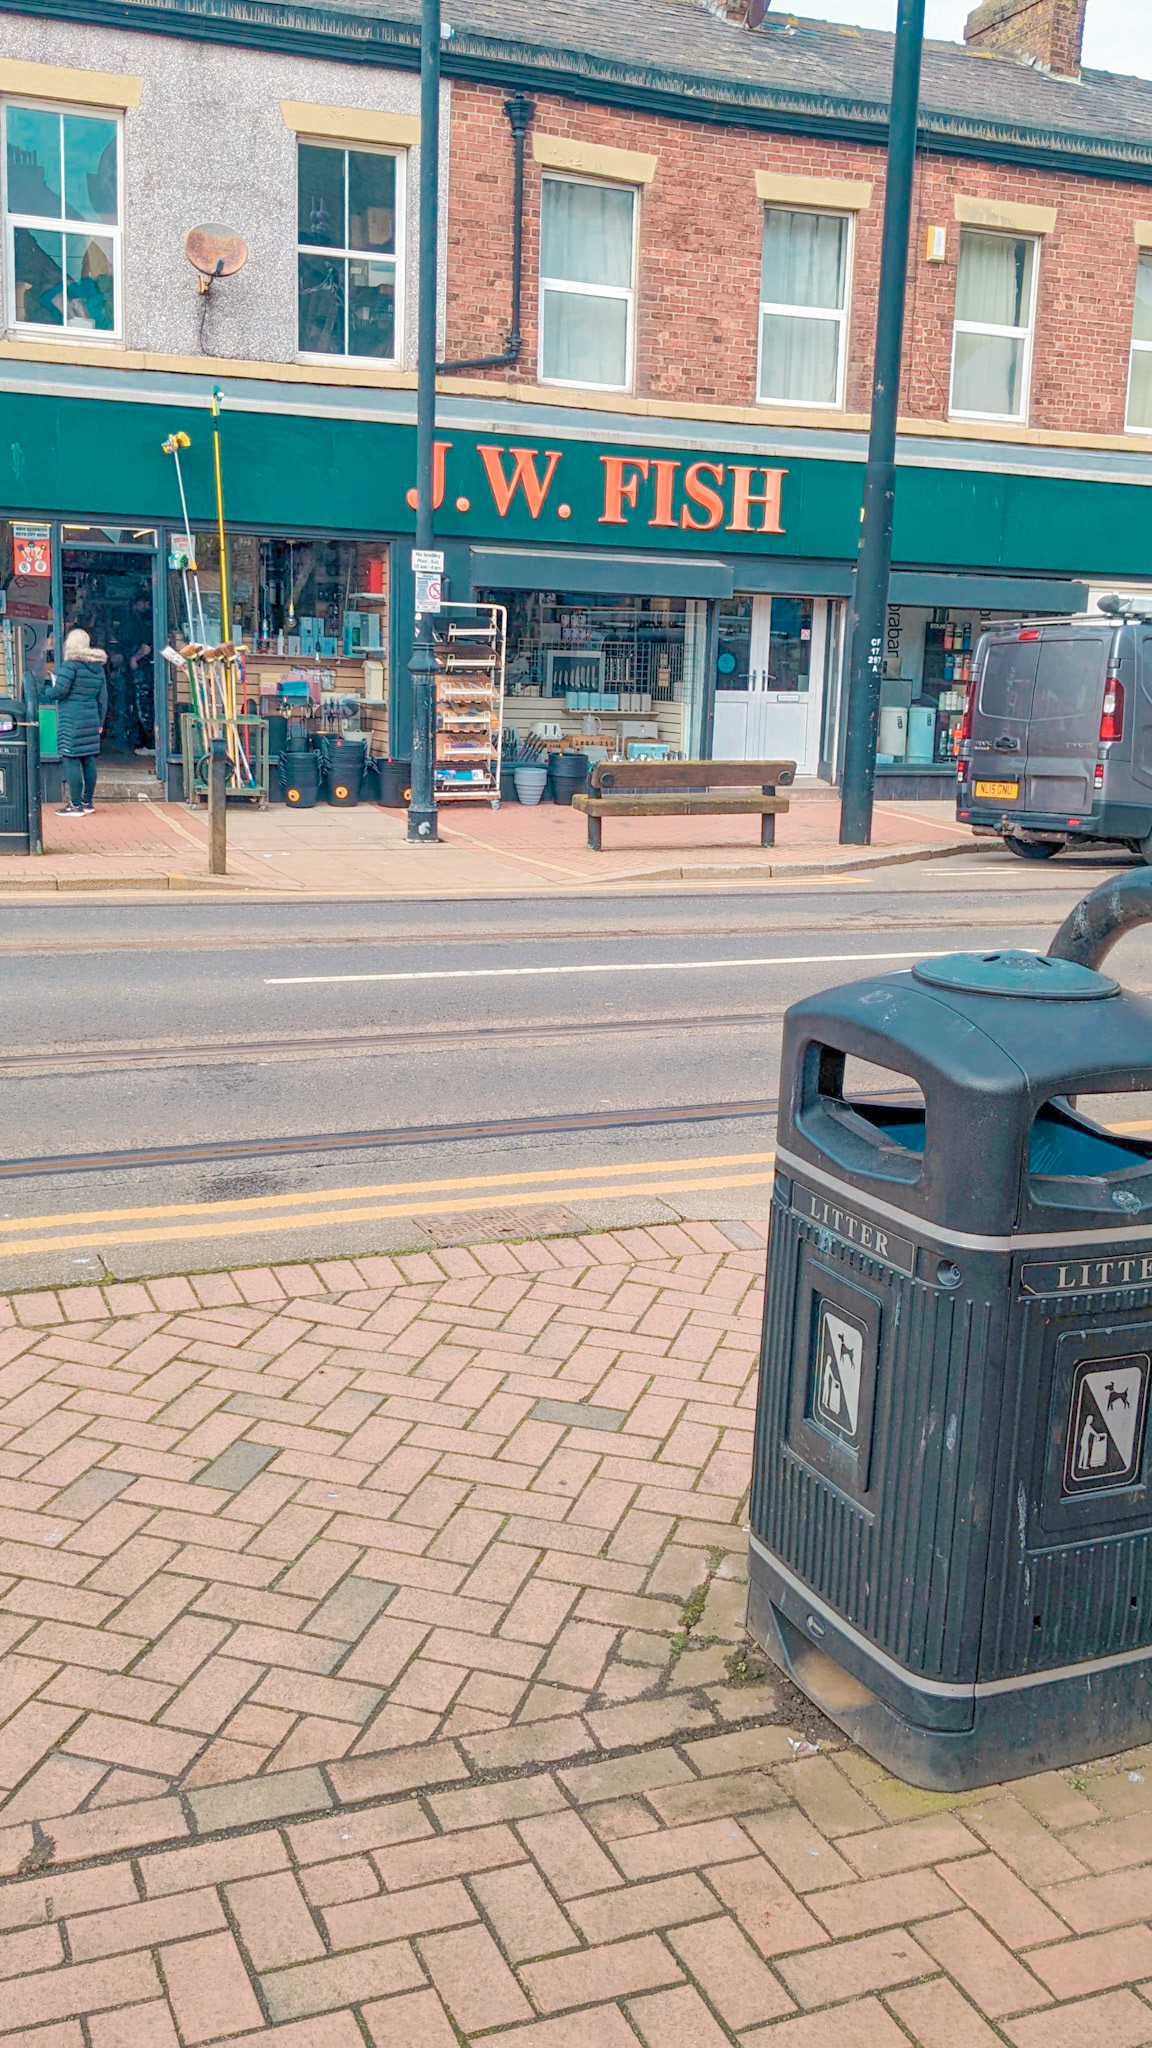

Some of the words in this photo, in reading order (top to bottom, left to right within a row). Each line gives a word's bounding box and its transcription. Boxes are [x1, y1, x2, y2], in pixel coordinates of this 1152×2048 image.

[597, 455, 789, 534] FISH
[871, 647, 880, 655] 17
[981, 784, 996, 794] NL15
[998, 785, 1012, 795] GNU
[811, 1196, 888, 1257] LITTER
